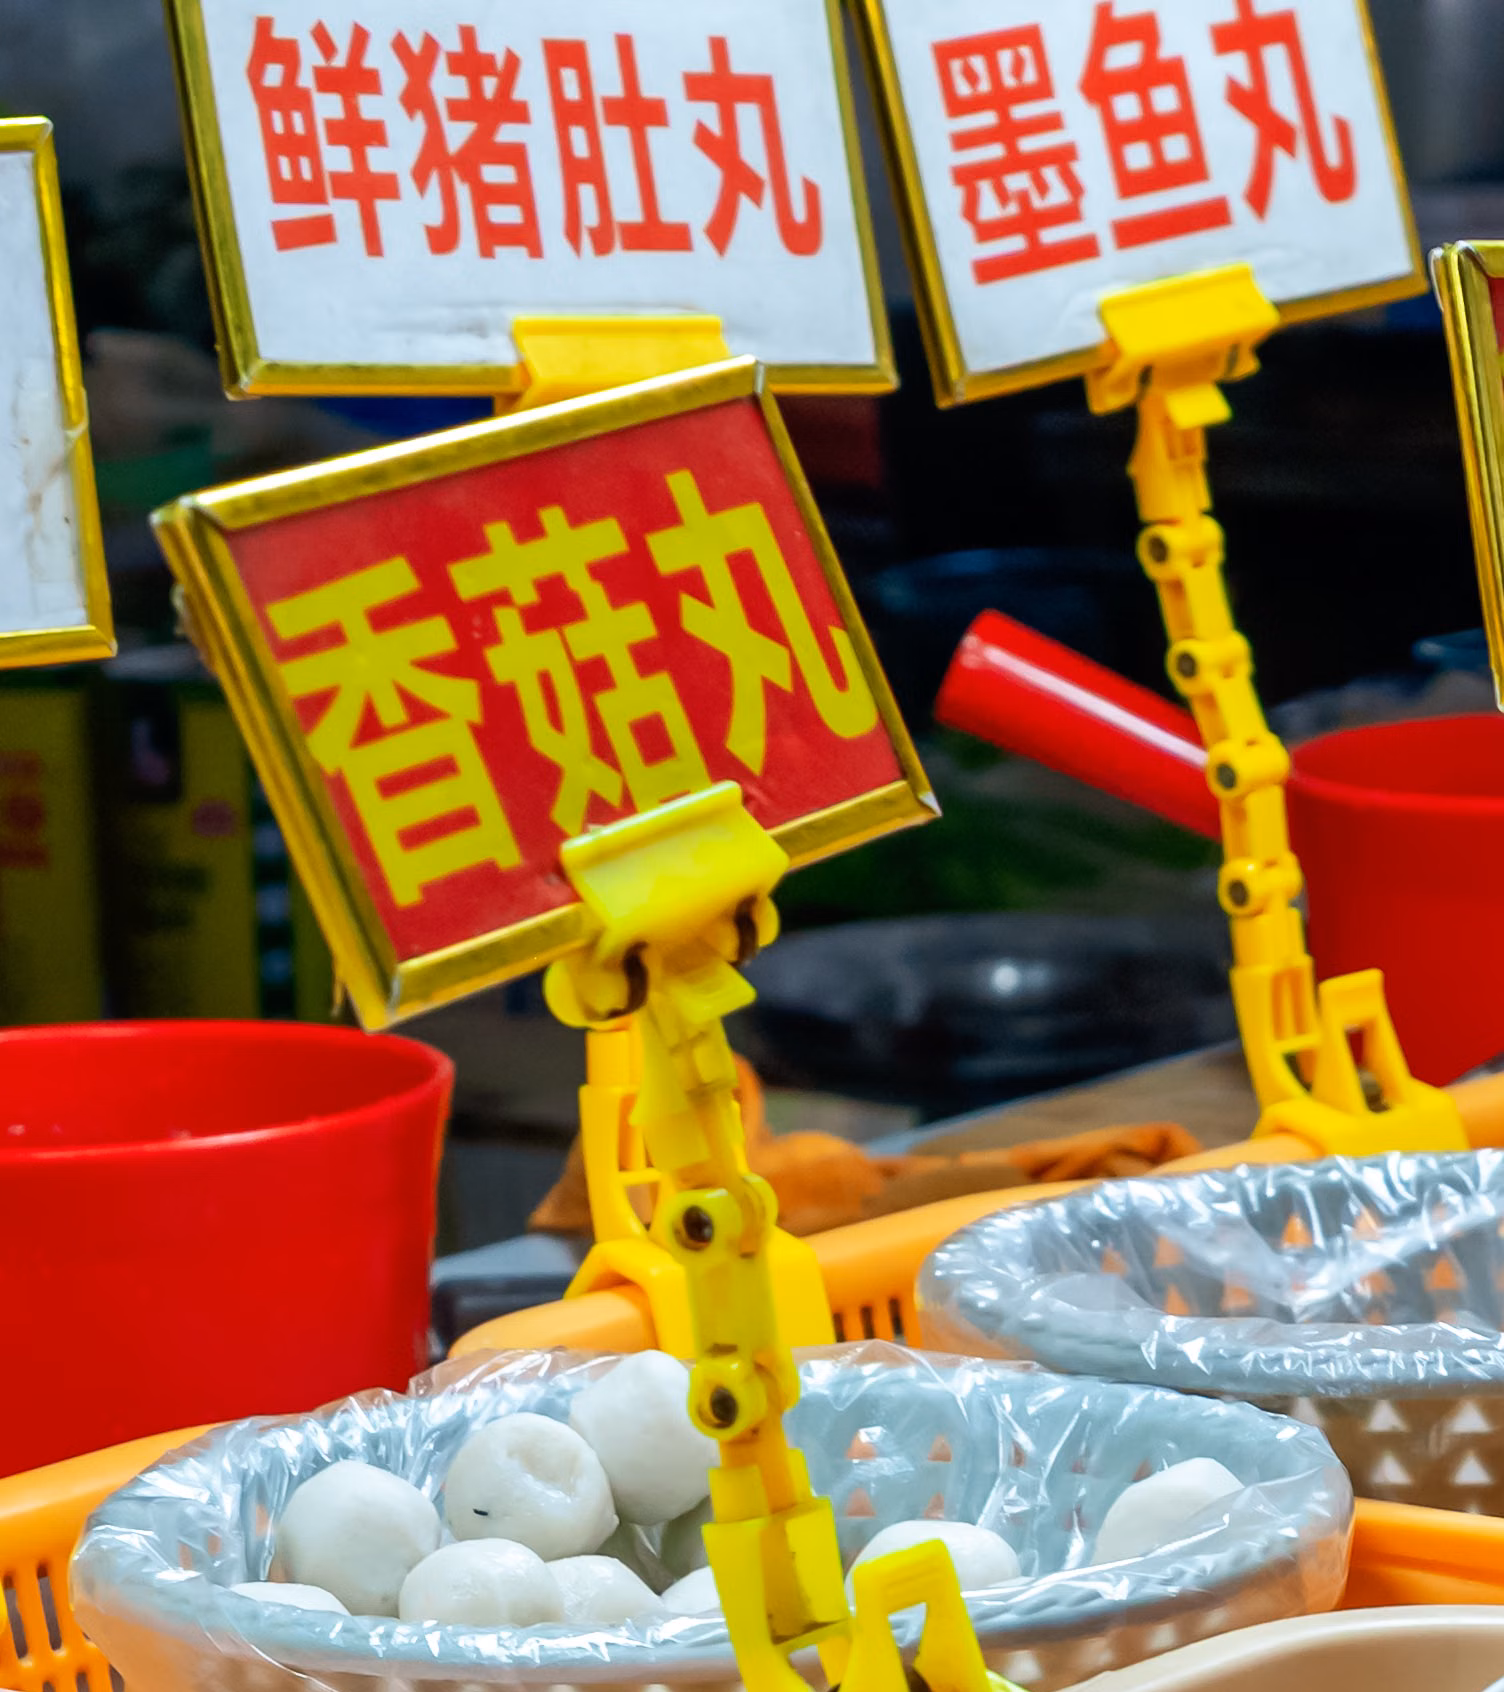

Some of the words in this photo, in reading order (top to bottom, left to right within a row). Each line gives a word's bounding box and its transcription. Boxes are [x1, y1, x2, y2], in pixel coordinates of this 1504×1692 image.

[246, 16, 823, 259] 鲜猪肚丸
[931, 0, 1358, 285] 墨鱼丸
[264, 469, 880, 909] 香菇丸
